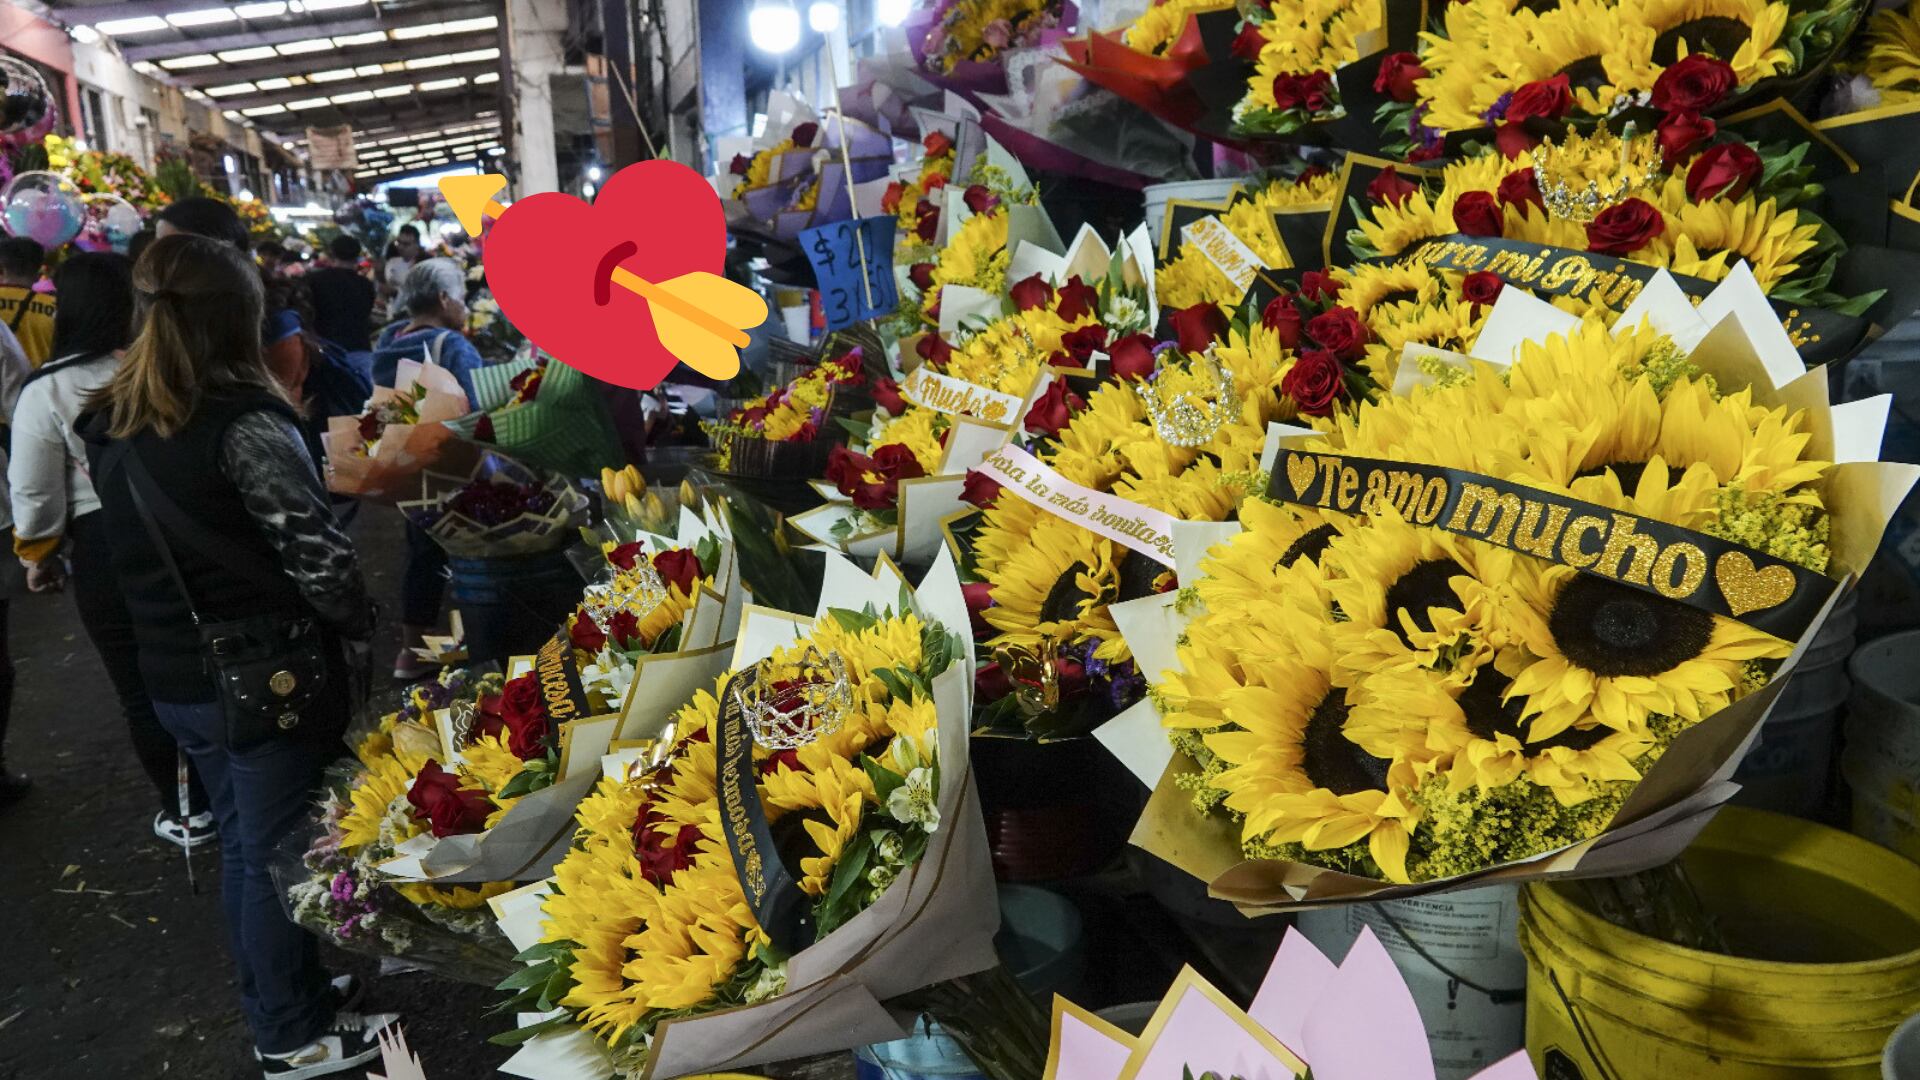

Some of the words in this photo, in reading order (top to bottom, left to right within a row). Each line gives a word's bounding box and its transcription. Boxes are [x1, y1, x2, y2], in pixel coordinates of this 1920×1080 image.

[1484, 248, 1551, 283] mi
[1318, 456, 1360, 510] Te
[1360, 469, 1448, 526] amo
[1448, 479, 1708, 600] mucho
[1392, 898, 1455, 913] VERTENCIA
